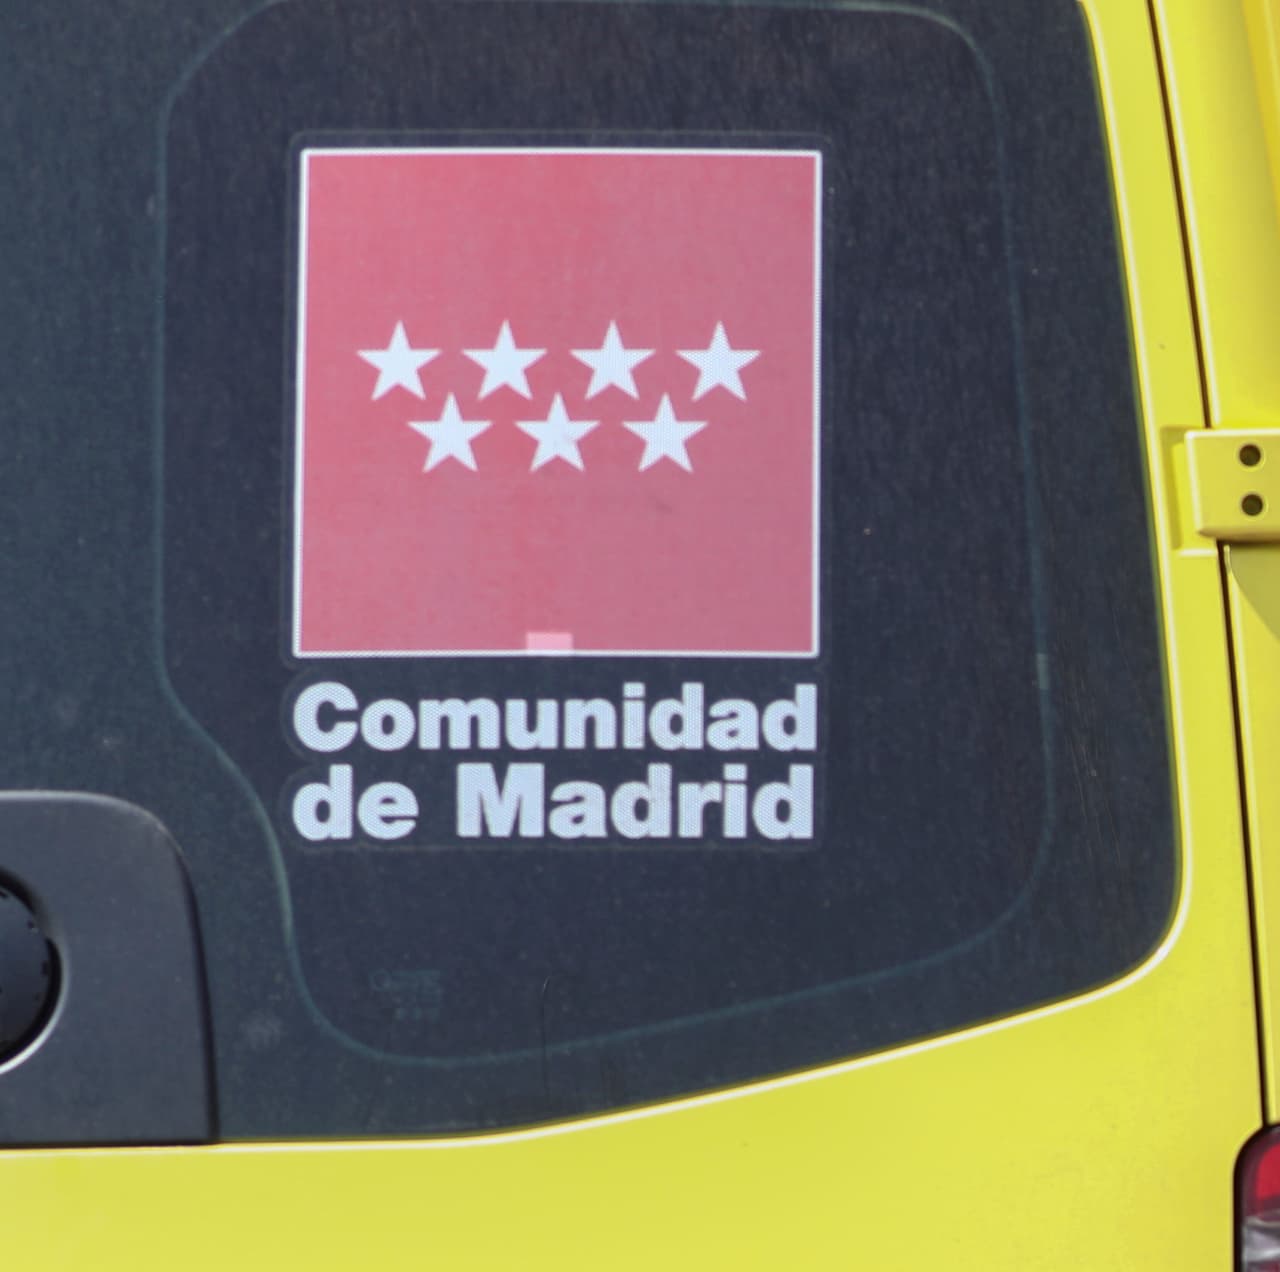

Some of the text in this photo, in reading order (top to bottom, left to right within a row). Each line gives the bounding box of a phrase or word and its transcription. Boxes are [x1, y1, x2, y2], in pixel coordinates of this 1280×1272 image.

[292, 681, 818, 752] Comunidad
[292, 762, 815, 841] de Madrid
